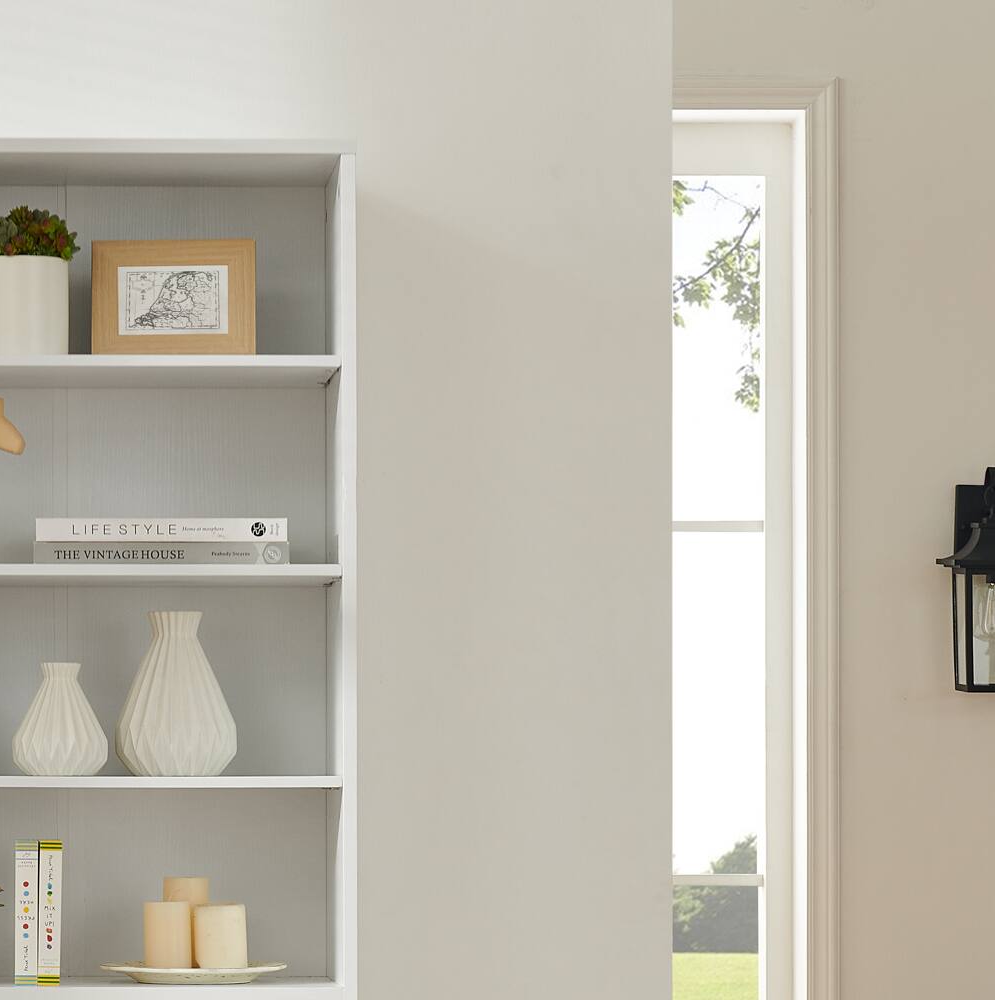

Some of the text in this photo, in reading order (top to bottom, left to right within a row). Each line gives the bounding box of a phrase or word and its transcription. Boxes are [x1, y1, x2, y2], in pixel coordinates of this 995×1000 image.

[72, 524, 111, 535] LIFE
[119, 524, 177, 535] STYLE
[54, 550, 80, 560] THE
[84, 550, 139, 560] VINTAGE
[141, 550, 185, 560] HOUSE
